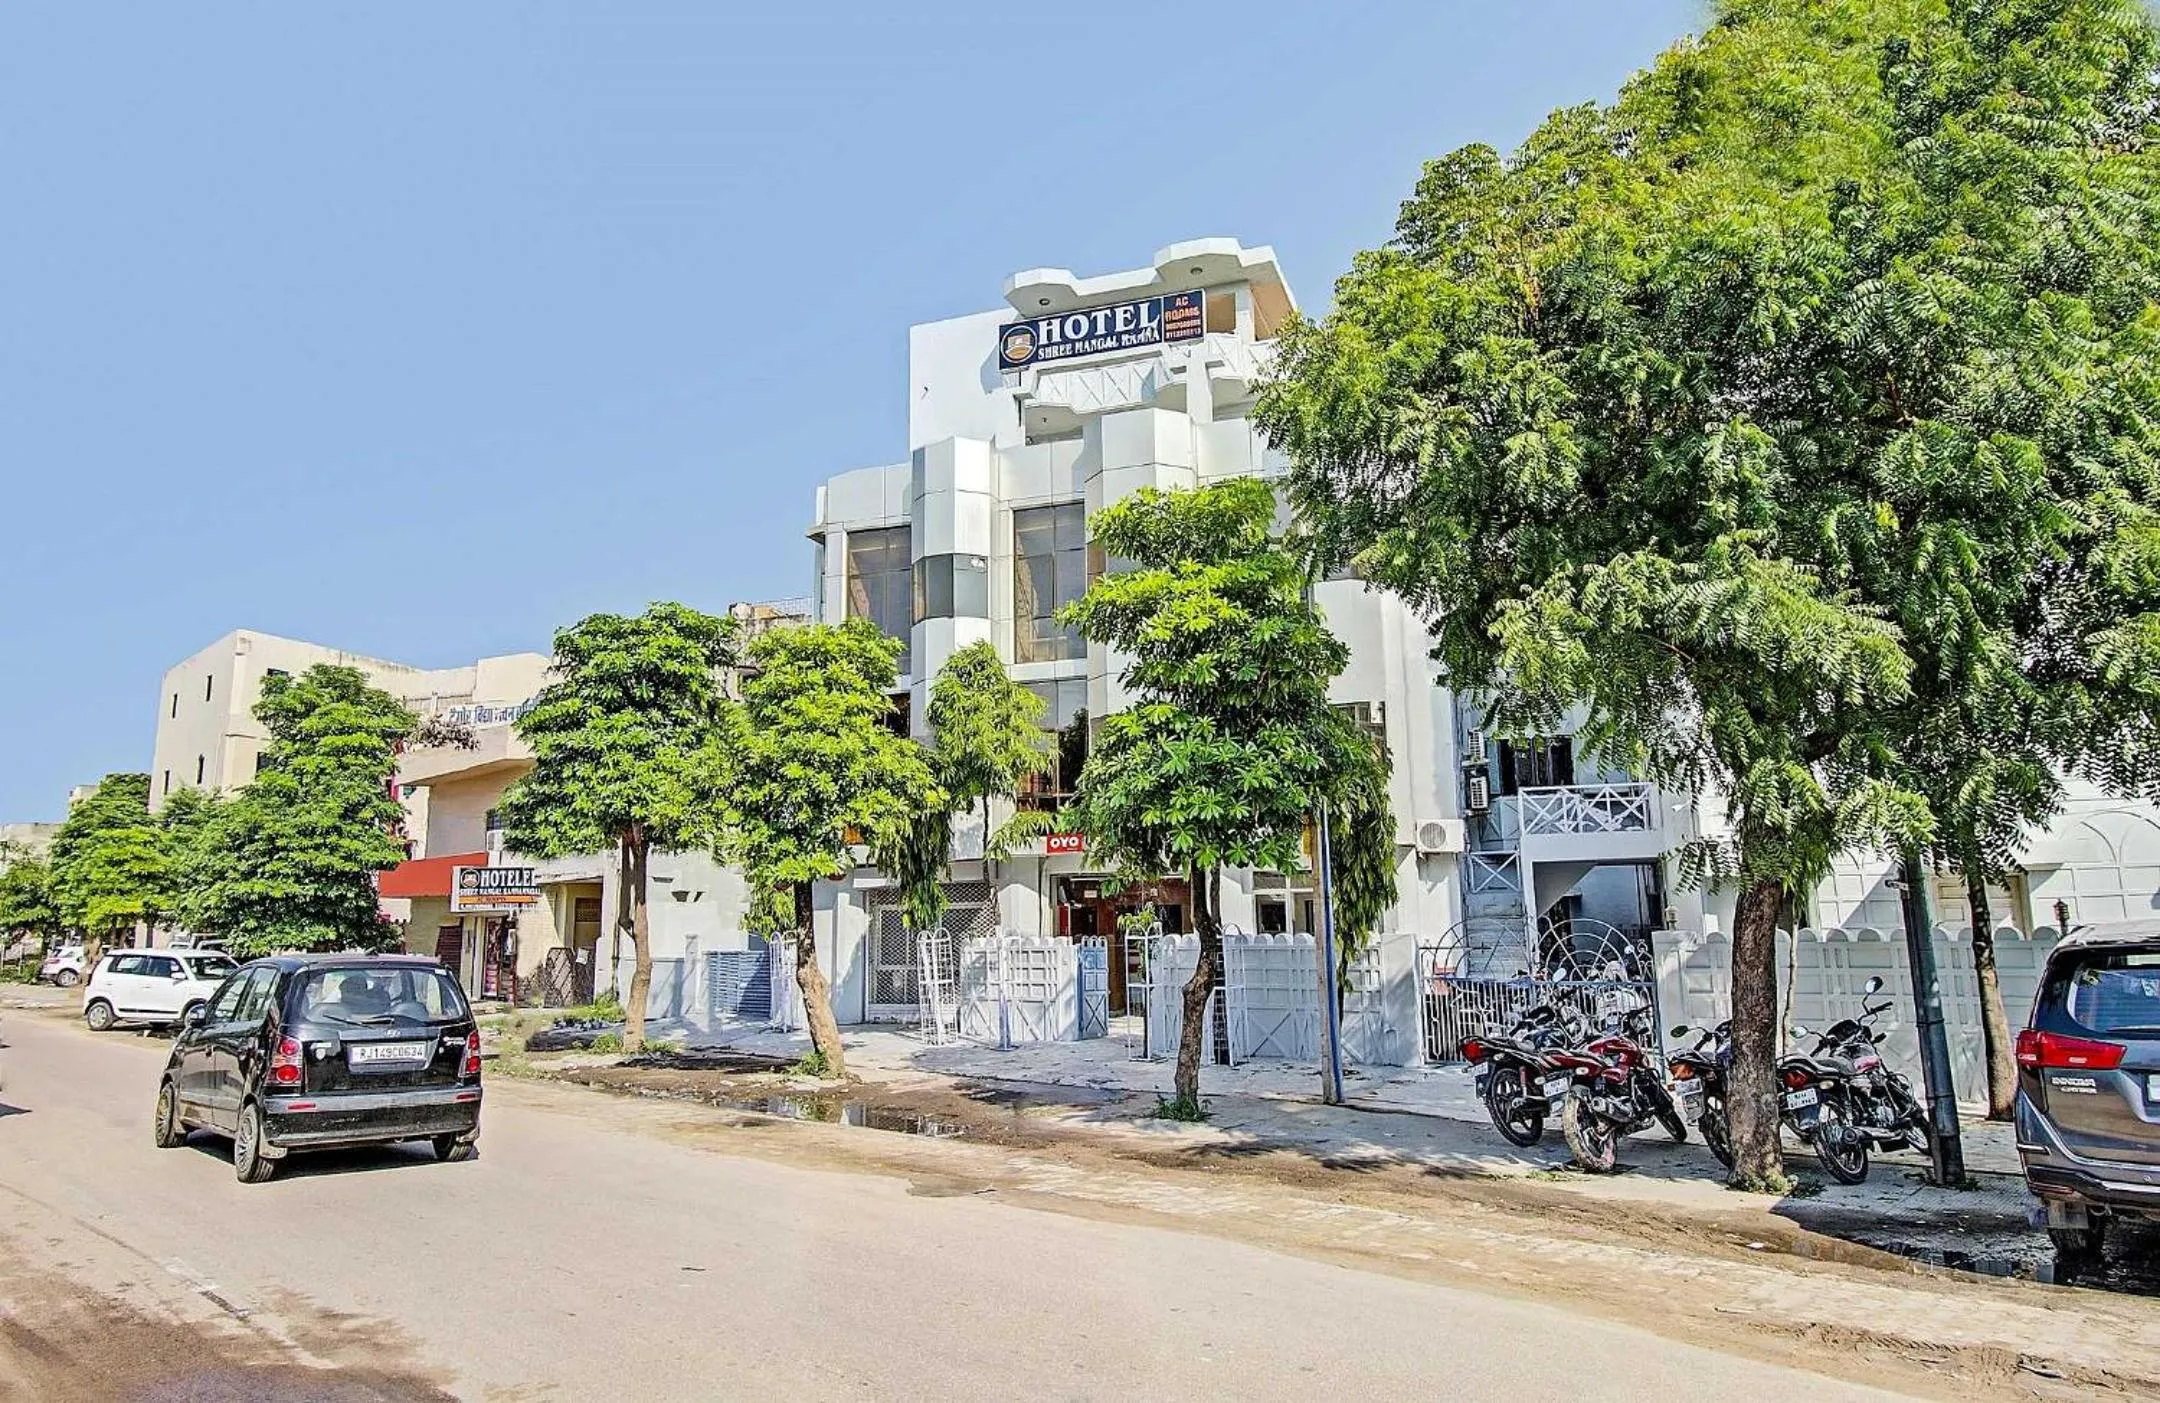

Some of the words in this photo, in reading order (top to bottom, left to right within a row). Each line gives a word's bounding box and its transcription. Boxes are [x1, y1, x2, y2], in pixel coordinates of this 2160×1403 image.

[1175, 296, 1189, 307] AC
[1164, 306, 1201, 322] ROOMS
[1038, 302, 1160, 345] HOTEL
[1038, 344, 1073, 360] SHREE
[1075, 334, 1120, 353] MANGAL
[1050, 836, 1079, 848] OYO
